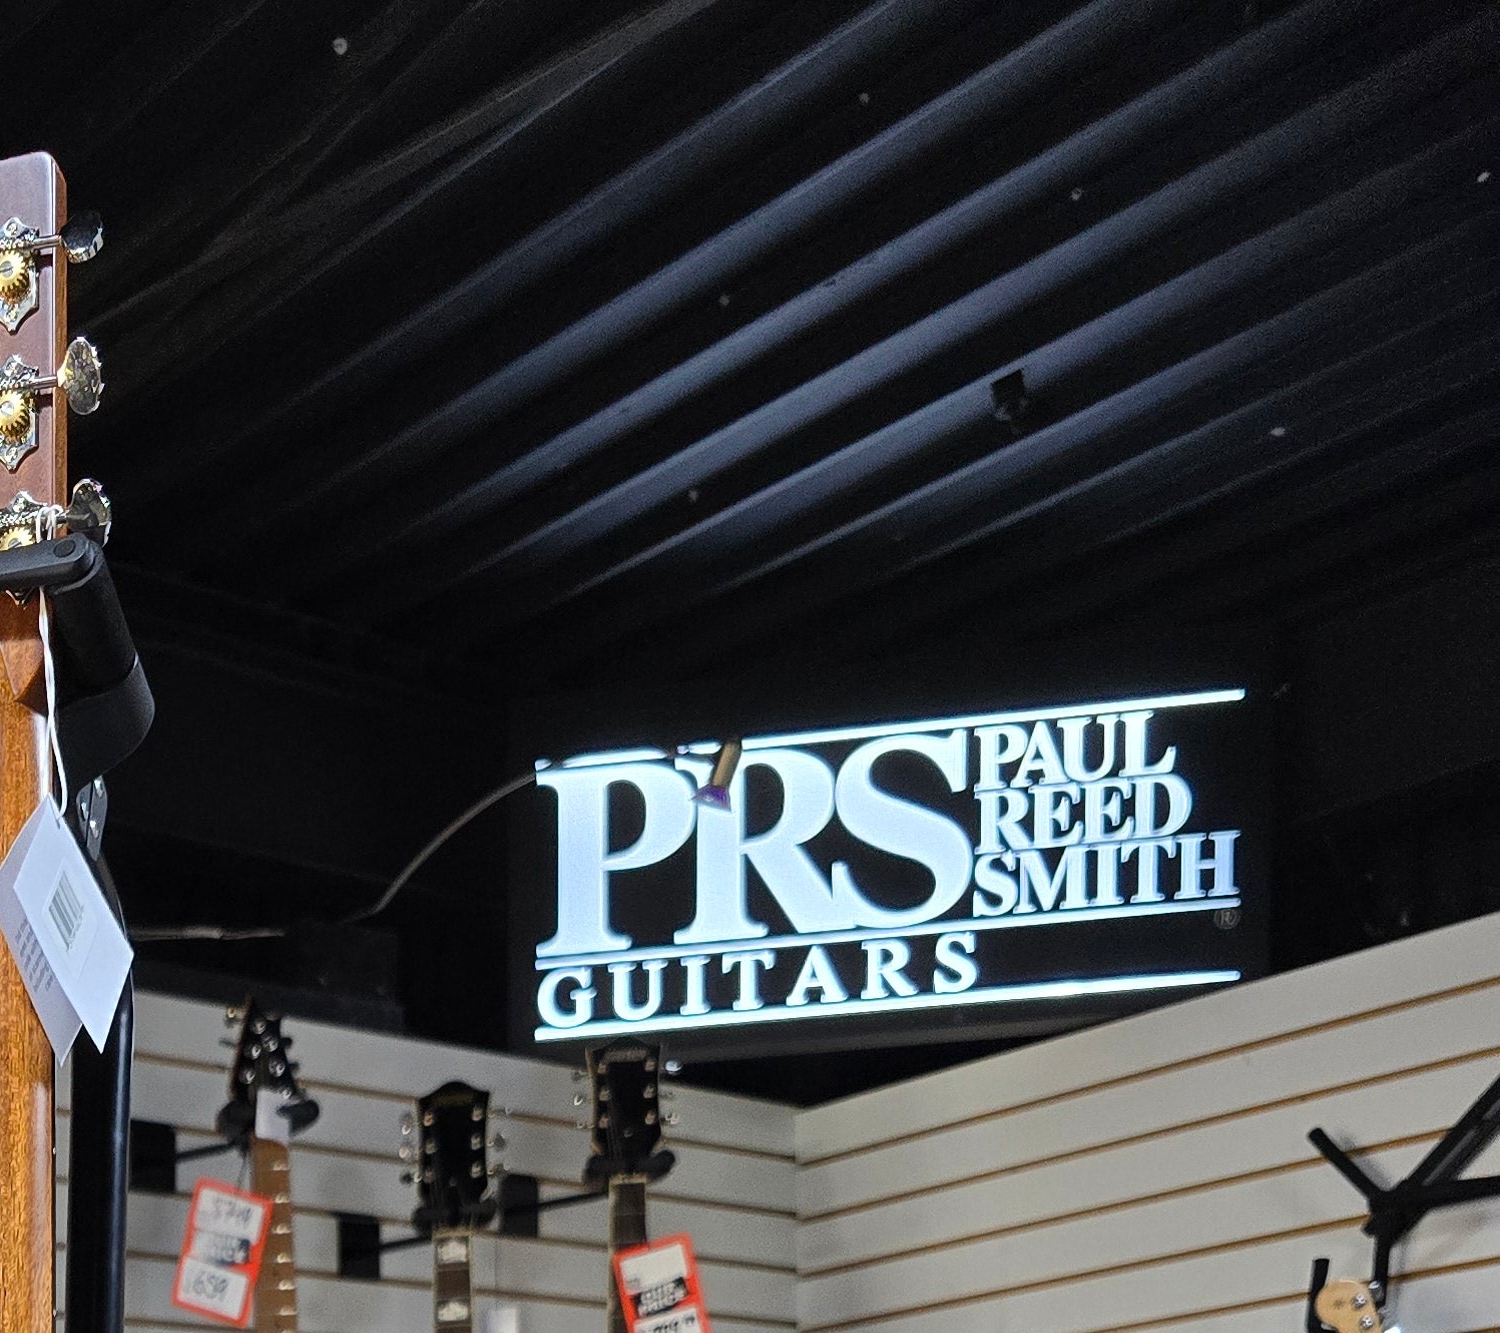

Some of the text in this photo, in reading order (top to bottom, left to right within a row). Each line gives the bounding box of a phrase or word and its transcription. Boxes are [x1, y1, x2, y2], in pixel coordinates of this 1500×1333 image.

[975, 711, 1176, 792] PAUL
[536, 731, 974, 957] PRS
[975, 773, 1193, 855] REED
[972, 829, 1242, 919] SMITH
[536, 931, 978, 1029] GUITARS
